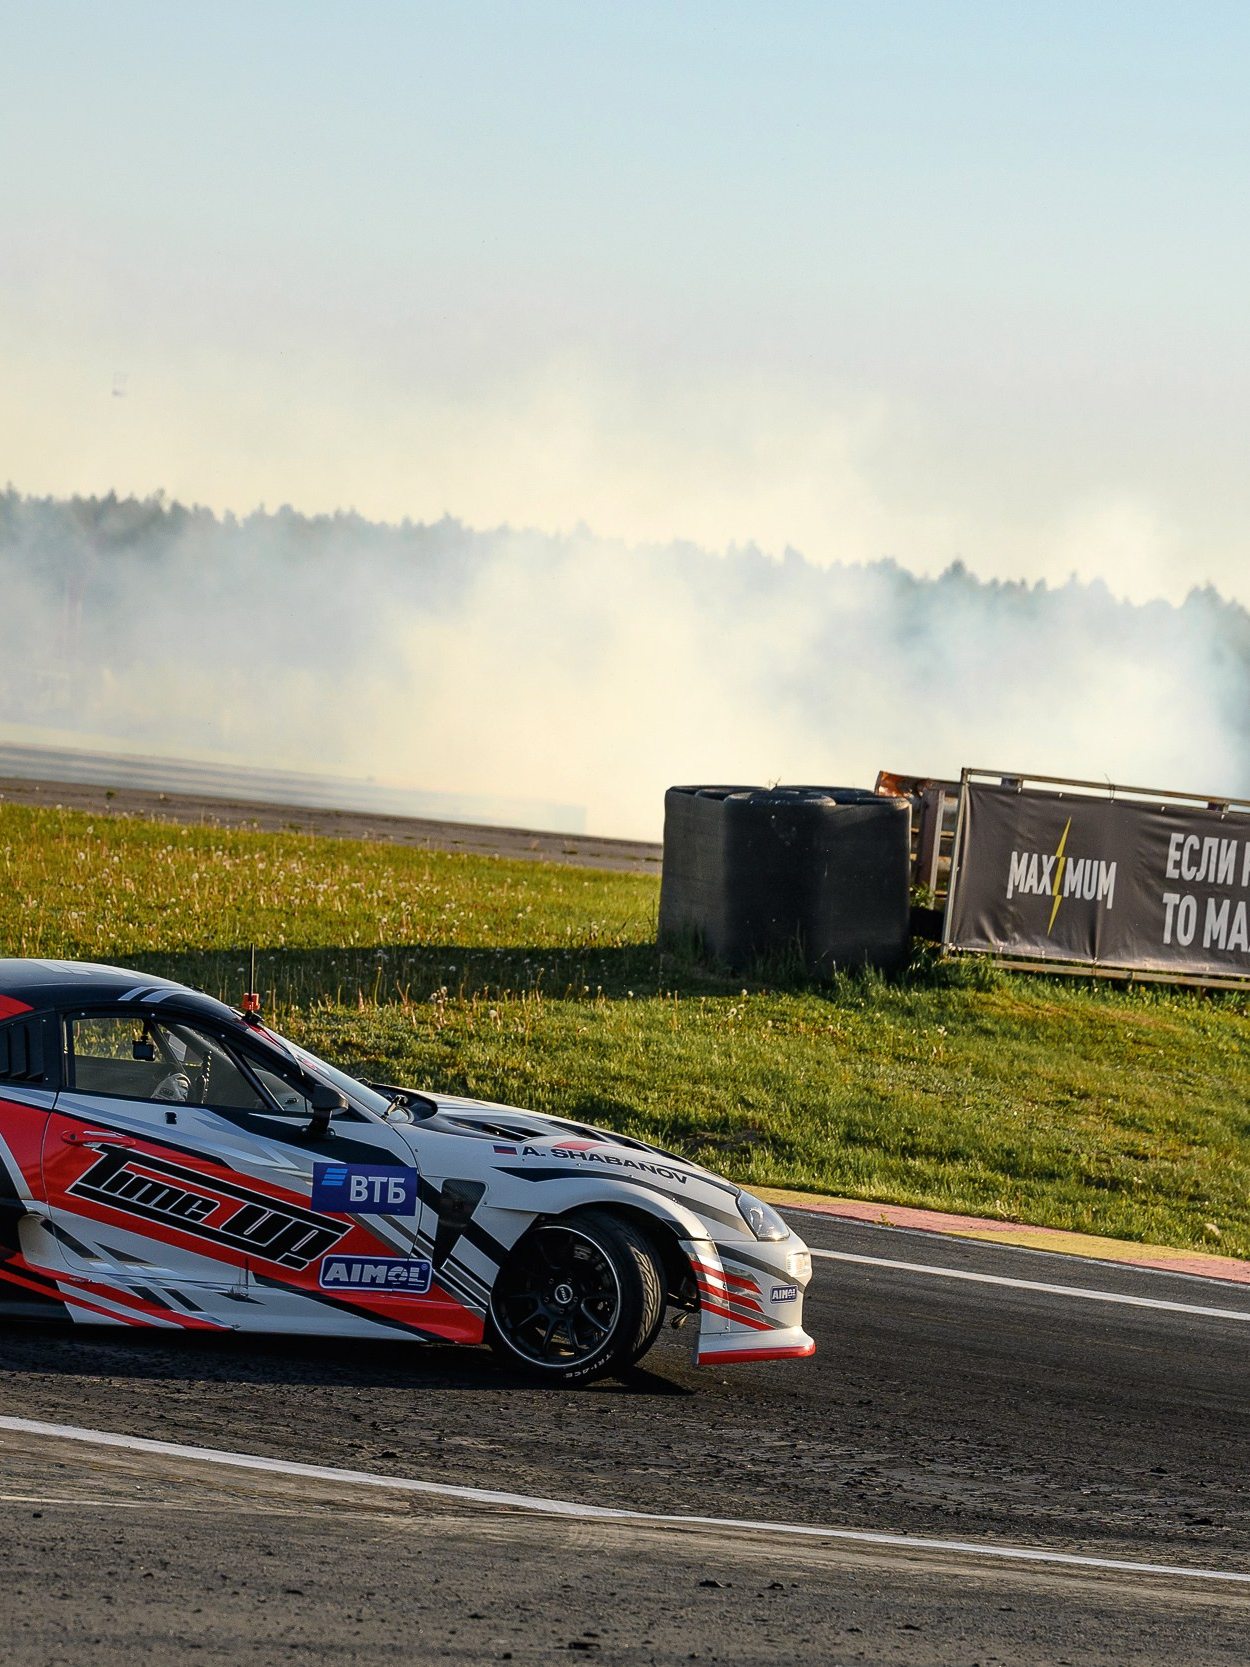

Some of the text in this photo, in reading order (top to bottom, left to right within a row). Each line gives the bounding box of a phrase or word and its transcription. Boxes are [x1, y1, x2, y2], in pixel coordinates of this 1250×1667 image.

[1166, 832, 1238, 887] ЕСЛИ
[1162, 892, 1250, 953] ТО МА
[521, 1146, 687, 1185] A. SHABANOV
[349, 1175, 406, 1204] ВТБ
